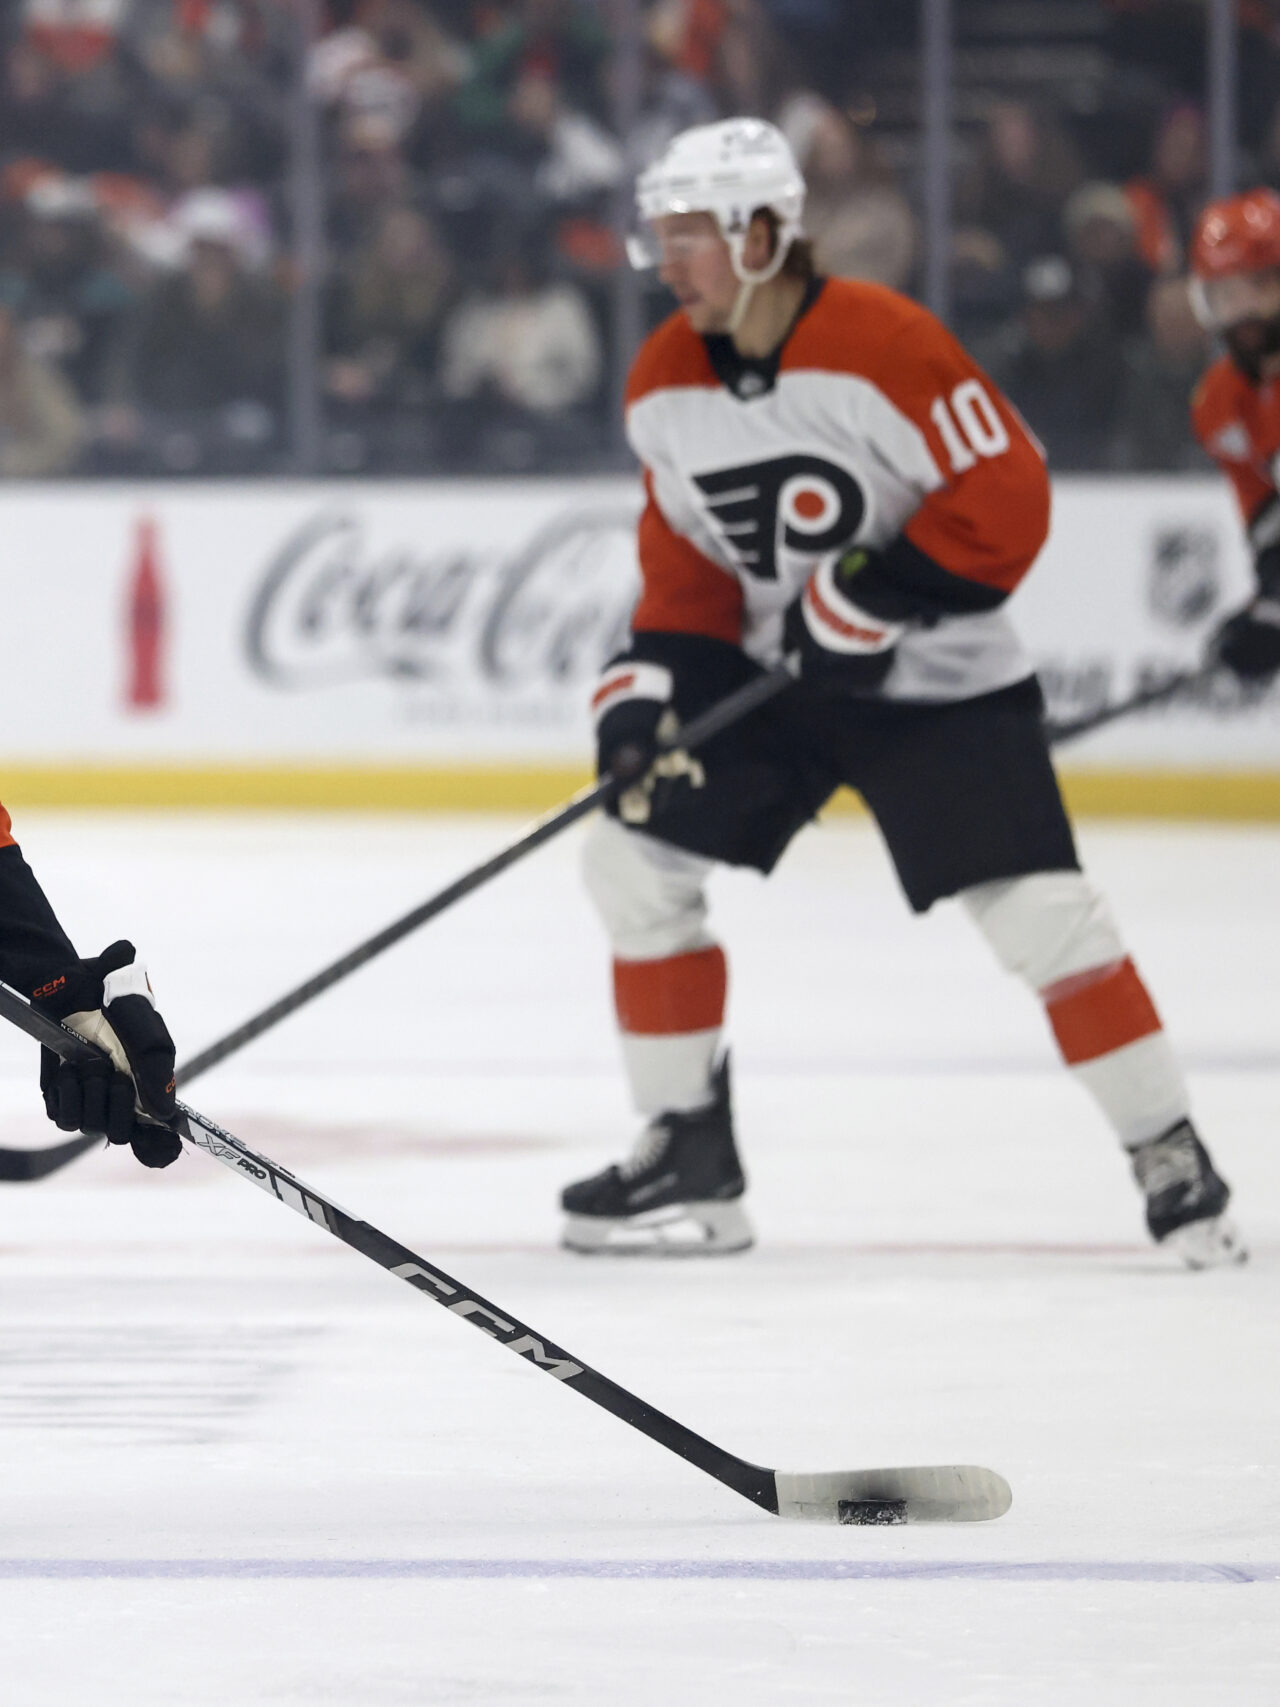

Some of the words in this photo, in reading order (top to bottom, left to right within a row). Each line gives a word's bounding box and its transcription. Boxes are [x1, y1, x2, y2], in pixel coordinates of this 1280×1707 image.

[930, 379, 1009, 474] 10
[32, 975, 66, 997] CCM
[196, 1133, 241, 1160] XF
[236, 1158, 267, 1180] PRO
[390, 1262, 584, 1380] CCM
